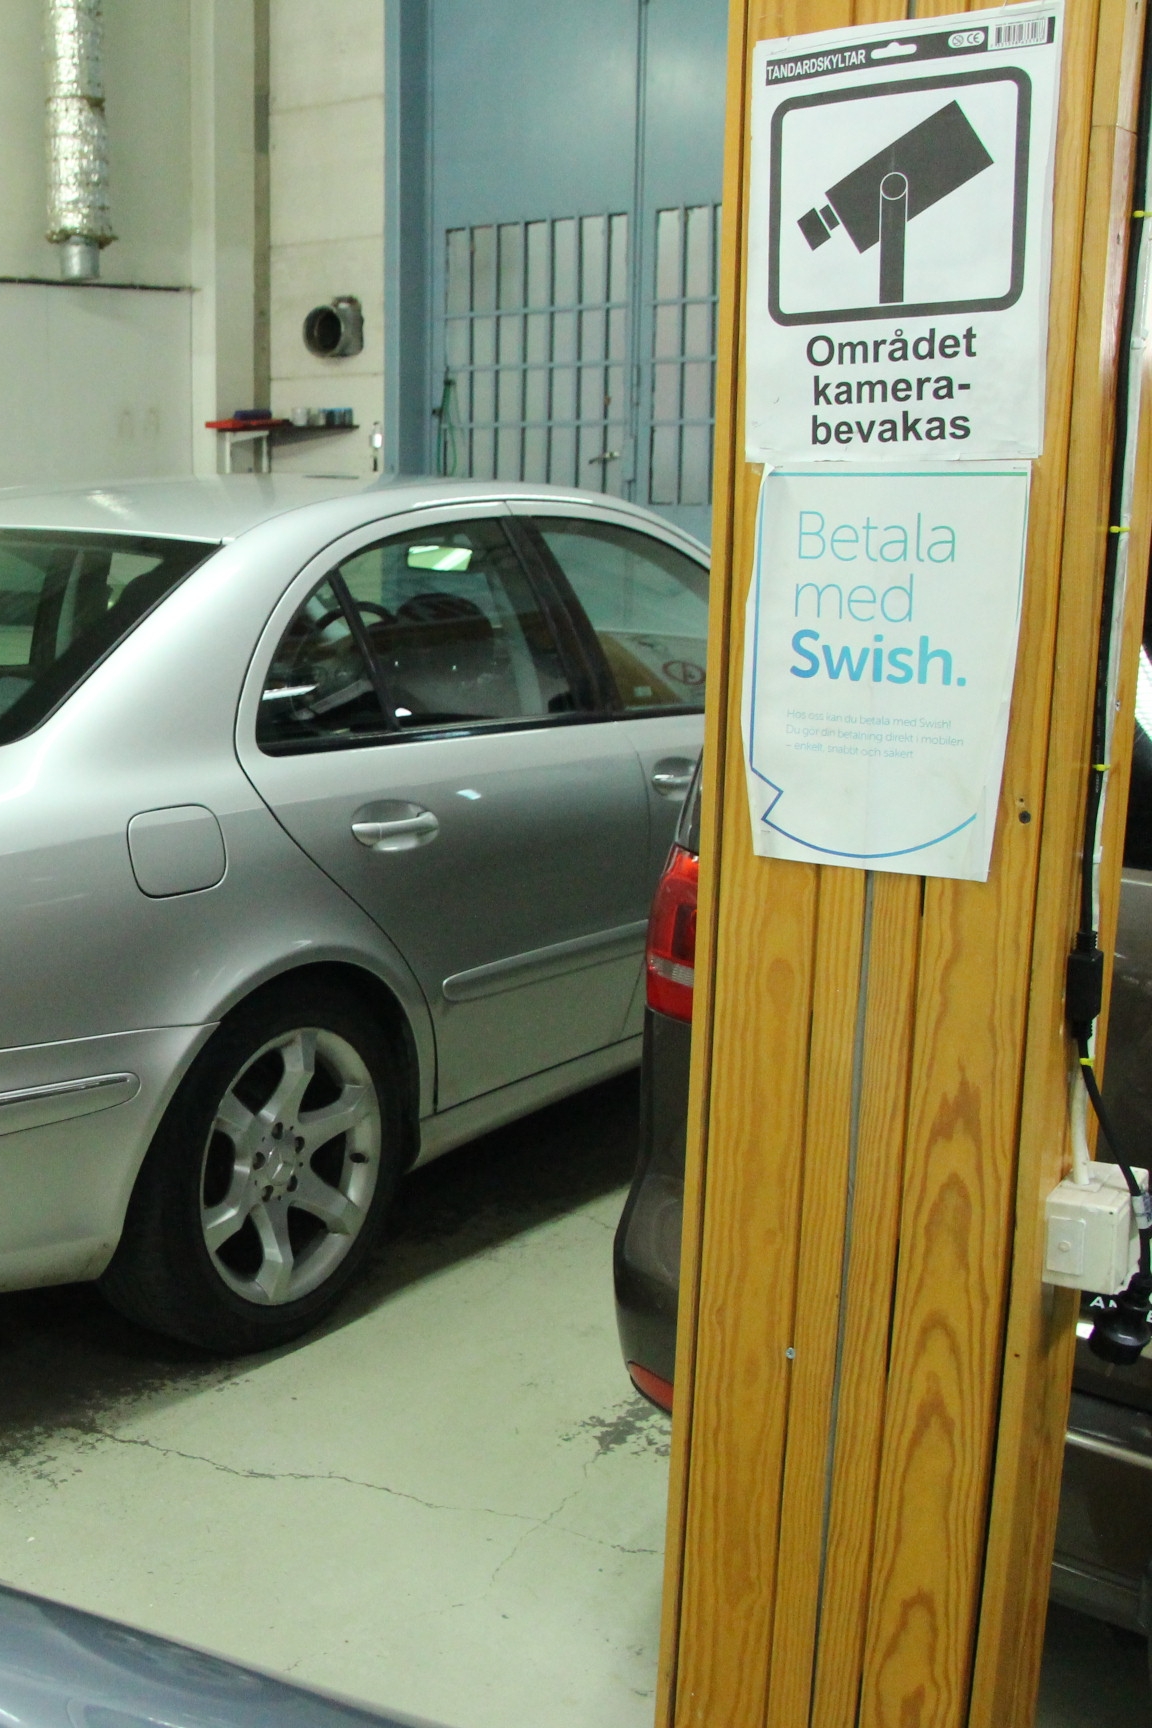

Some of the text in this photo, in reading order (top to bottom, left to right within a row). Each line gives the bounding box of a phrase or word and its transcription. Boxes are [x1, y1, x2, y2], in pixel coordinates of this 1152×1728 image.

[806, 326, 977, 366] Området
[813, 375, 971, 406] kamera-
[811, 410, 971, 445] bevakas
[798, 511, 955, 563] Betala
[794, 573, 914, 623] med
[789, 628, 967, 687] Swish.
[859, 715, 891, 726] betala
